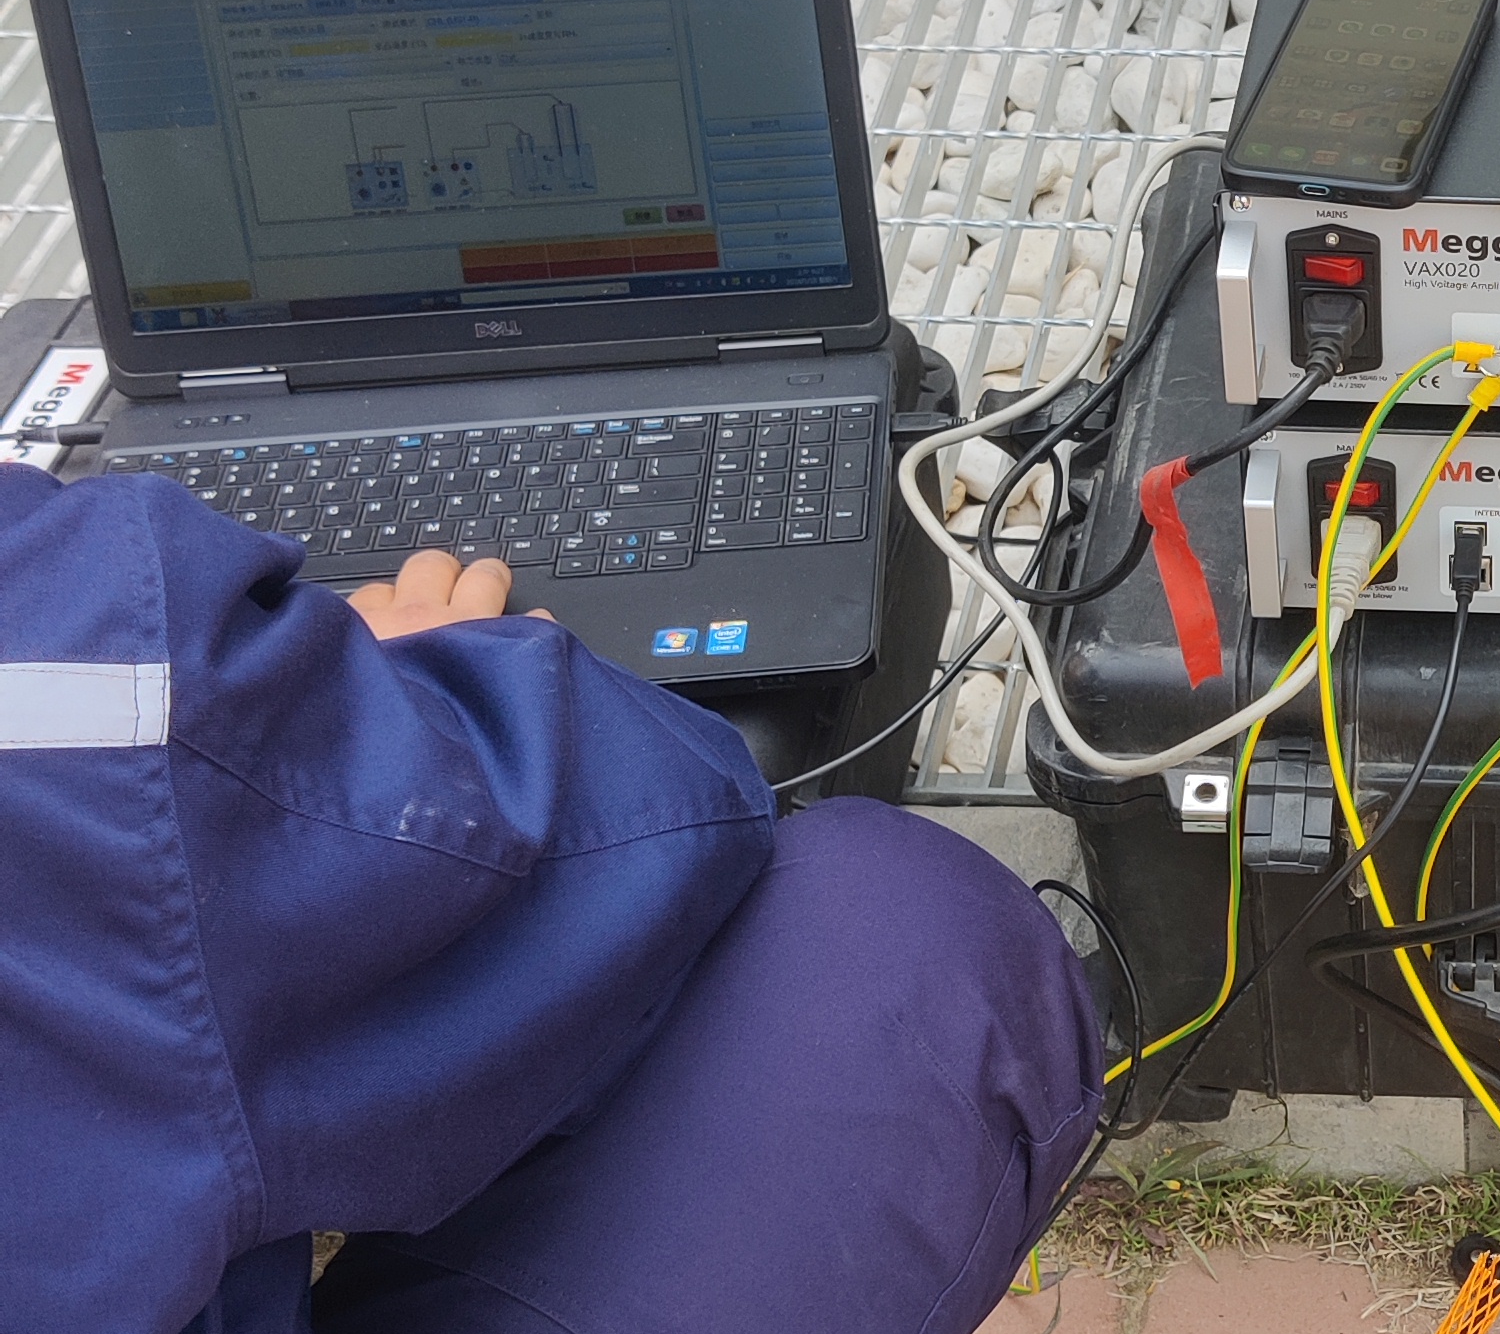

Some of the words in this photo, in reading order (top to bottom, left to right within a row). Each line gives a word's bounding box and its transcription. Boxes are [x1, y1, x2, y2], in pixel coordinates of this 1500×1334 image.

[1316, 210, 1348, 218] MAINS
[1404, 261, 1481, 278] VAX020
[1404, 279, 1427, 290] High
[1431, 280, 1468, 291] Voltage
[475, 321, 522, 338] DELL
[1418, 375, 1440, 389] CE
[1336, 444, 1355, 452] MAI
